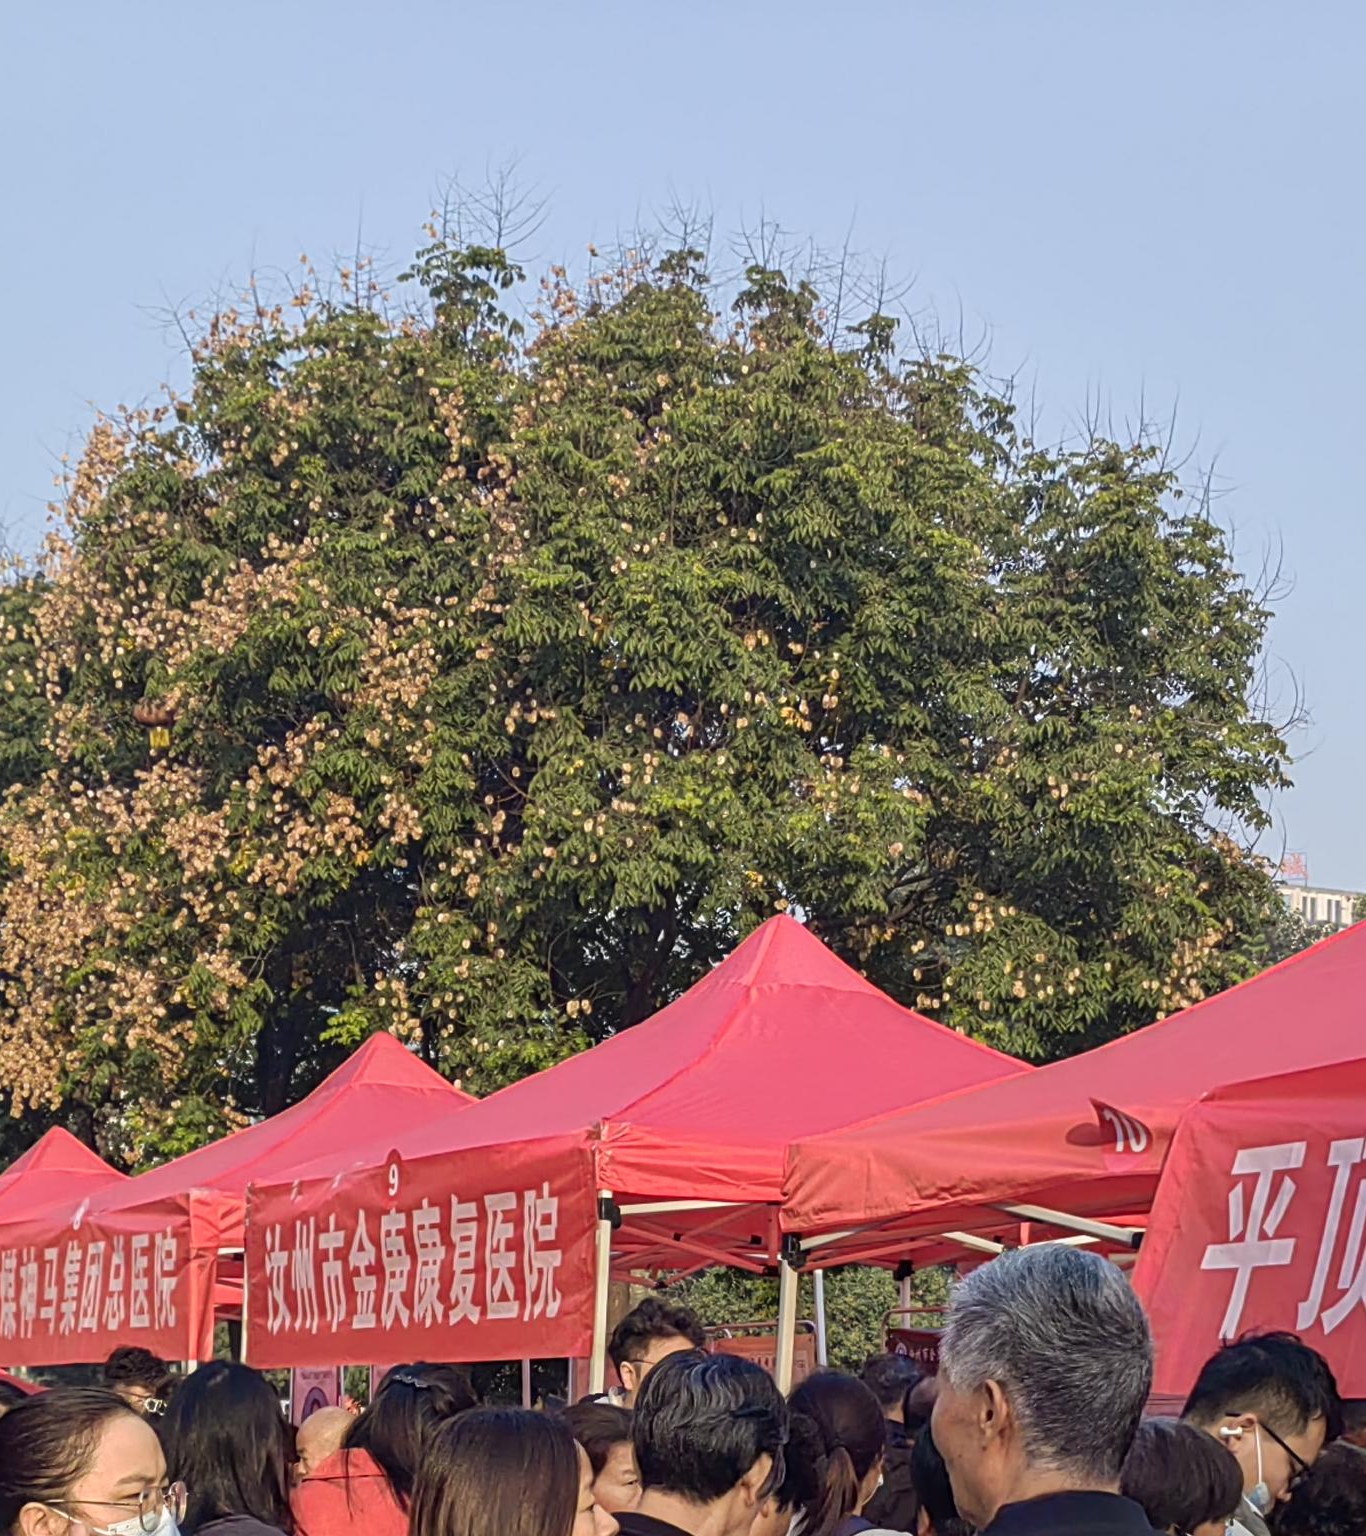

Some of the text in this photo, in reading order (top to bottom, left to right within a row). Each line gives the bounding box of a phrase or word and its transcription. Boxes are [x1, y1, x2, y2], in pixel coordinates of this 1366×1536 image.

[388, 1163, 399, 1196] 9
[265, 1181, 562, 1335] 汝州市金庚康复医院
